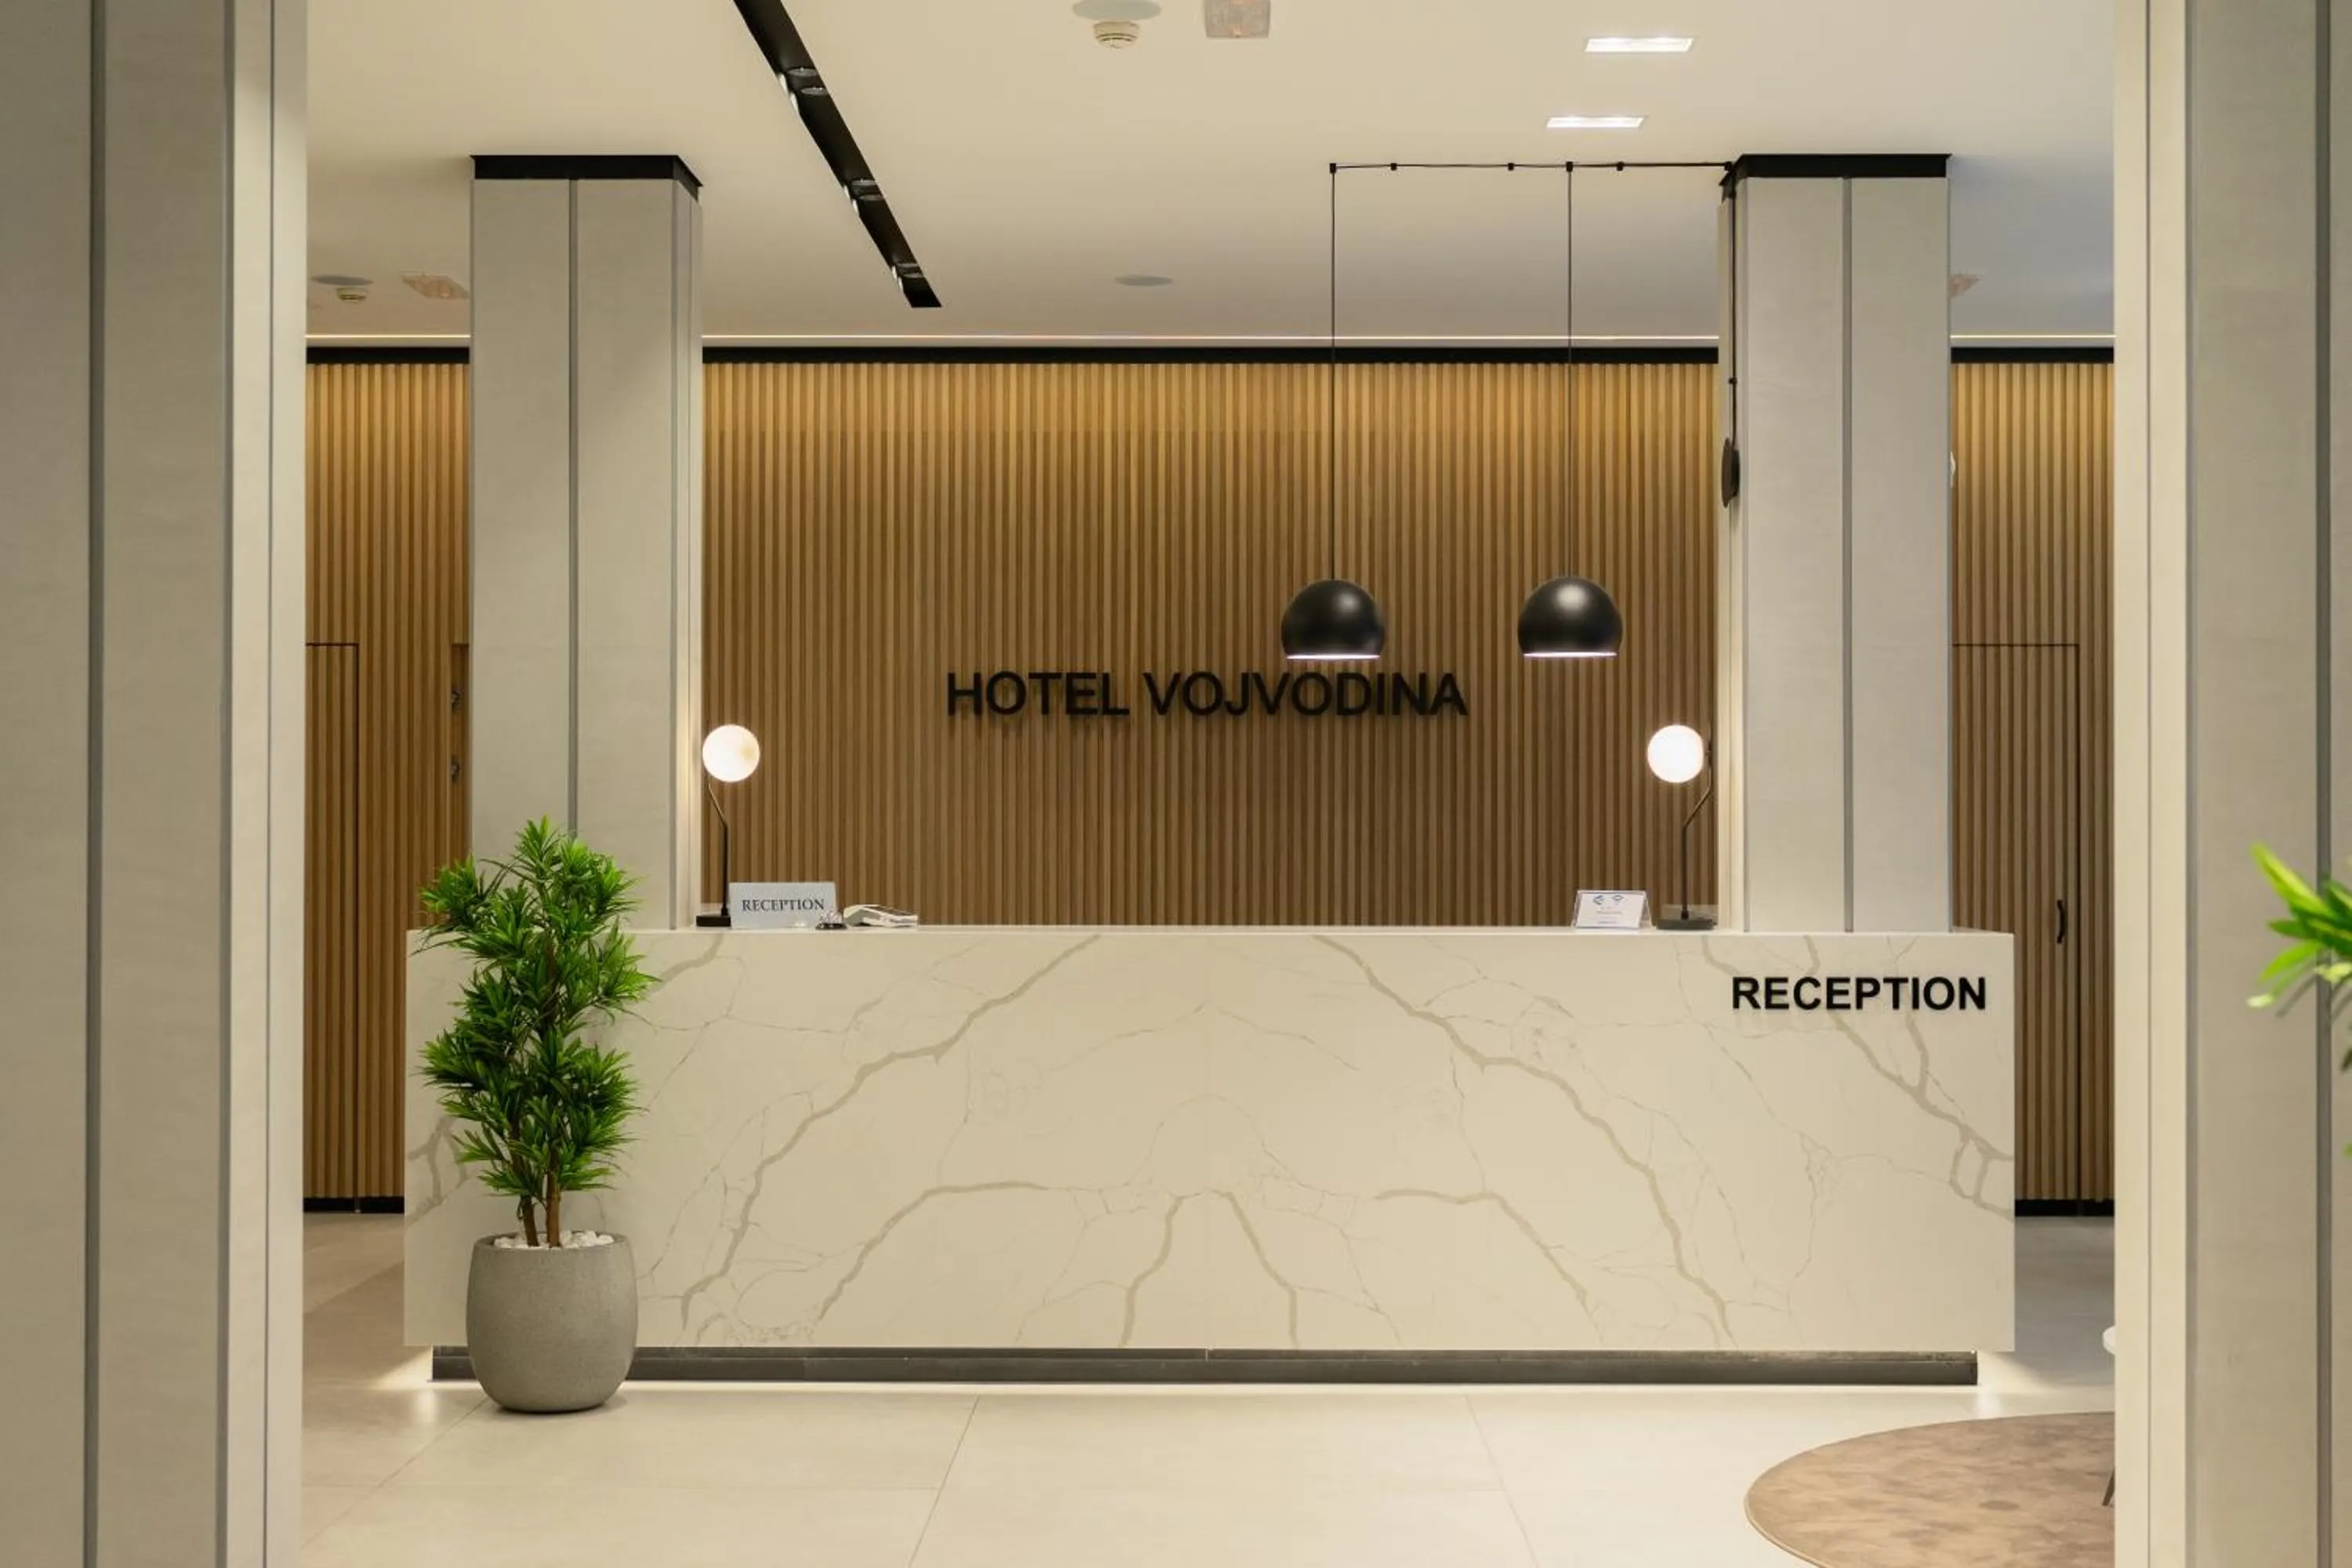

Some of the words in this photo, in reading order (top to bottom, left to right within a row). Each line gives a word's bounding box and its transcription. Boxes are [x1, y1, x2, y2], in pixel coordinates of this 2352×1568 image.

[947, 671, 1130, 717] HOTEL
[1142, 671, 1468, 717] VOJVODINA
[742, 899, 824, 911] RECEPTION
[1732, 977, 1986, 1010] RECEPTION
